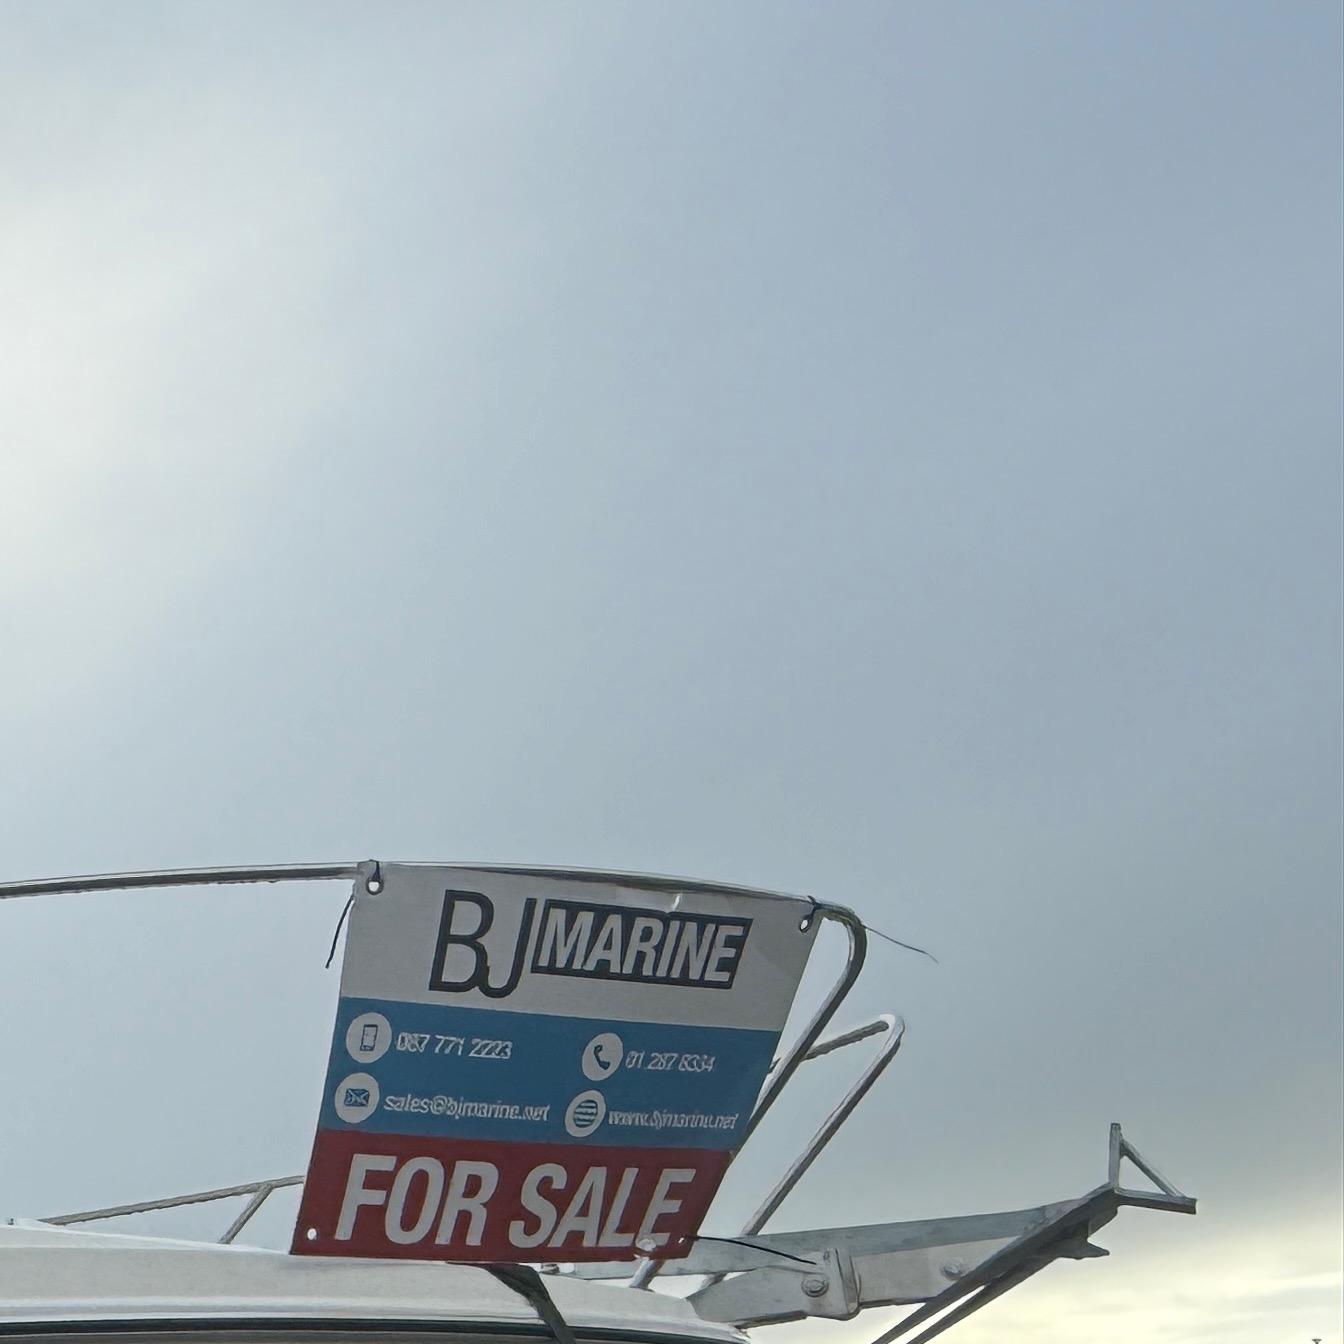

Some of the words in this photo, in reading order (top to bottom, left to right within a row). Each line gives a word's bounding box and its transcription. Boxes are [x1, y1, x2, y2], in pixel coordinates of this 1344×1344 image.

[429, 889, 537, 998] BJ
[536, 905, 746, 984] MARINE
[335, 1153, 499, 1246] FOR
[508, 1162, 697, 1249] SALE
